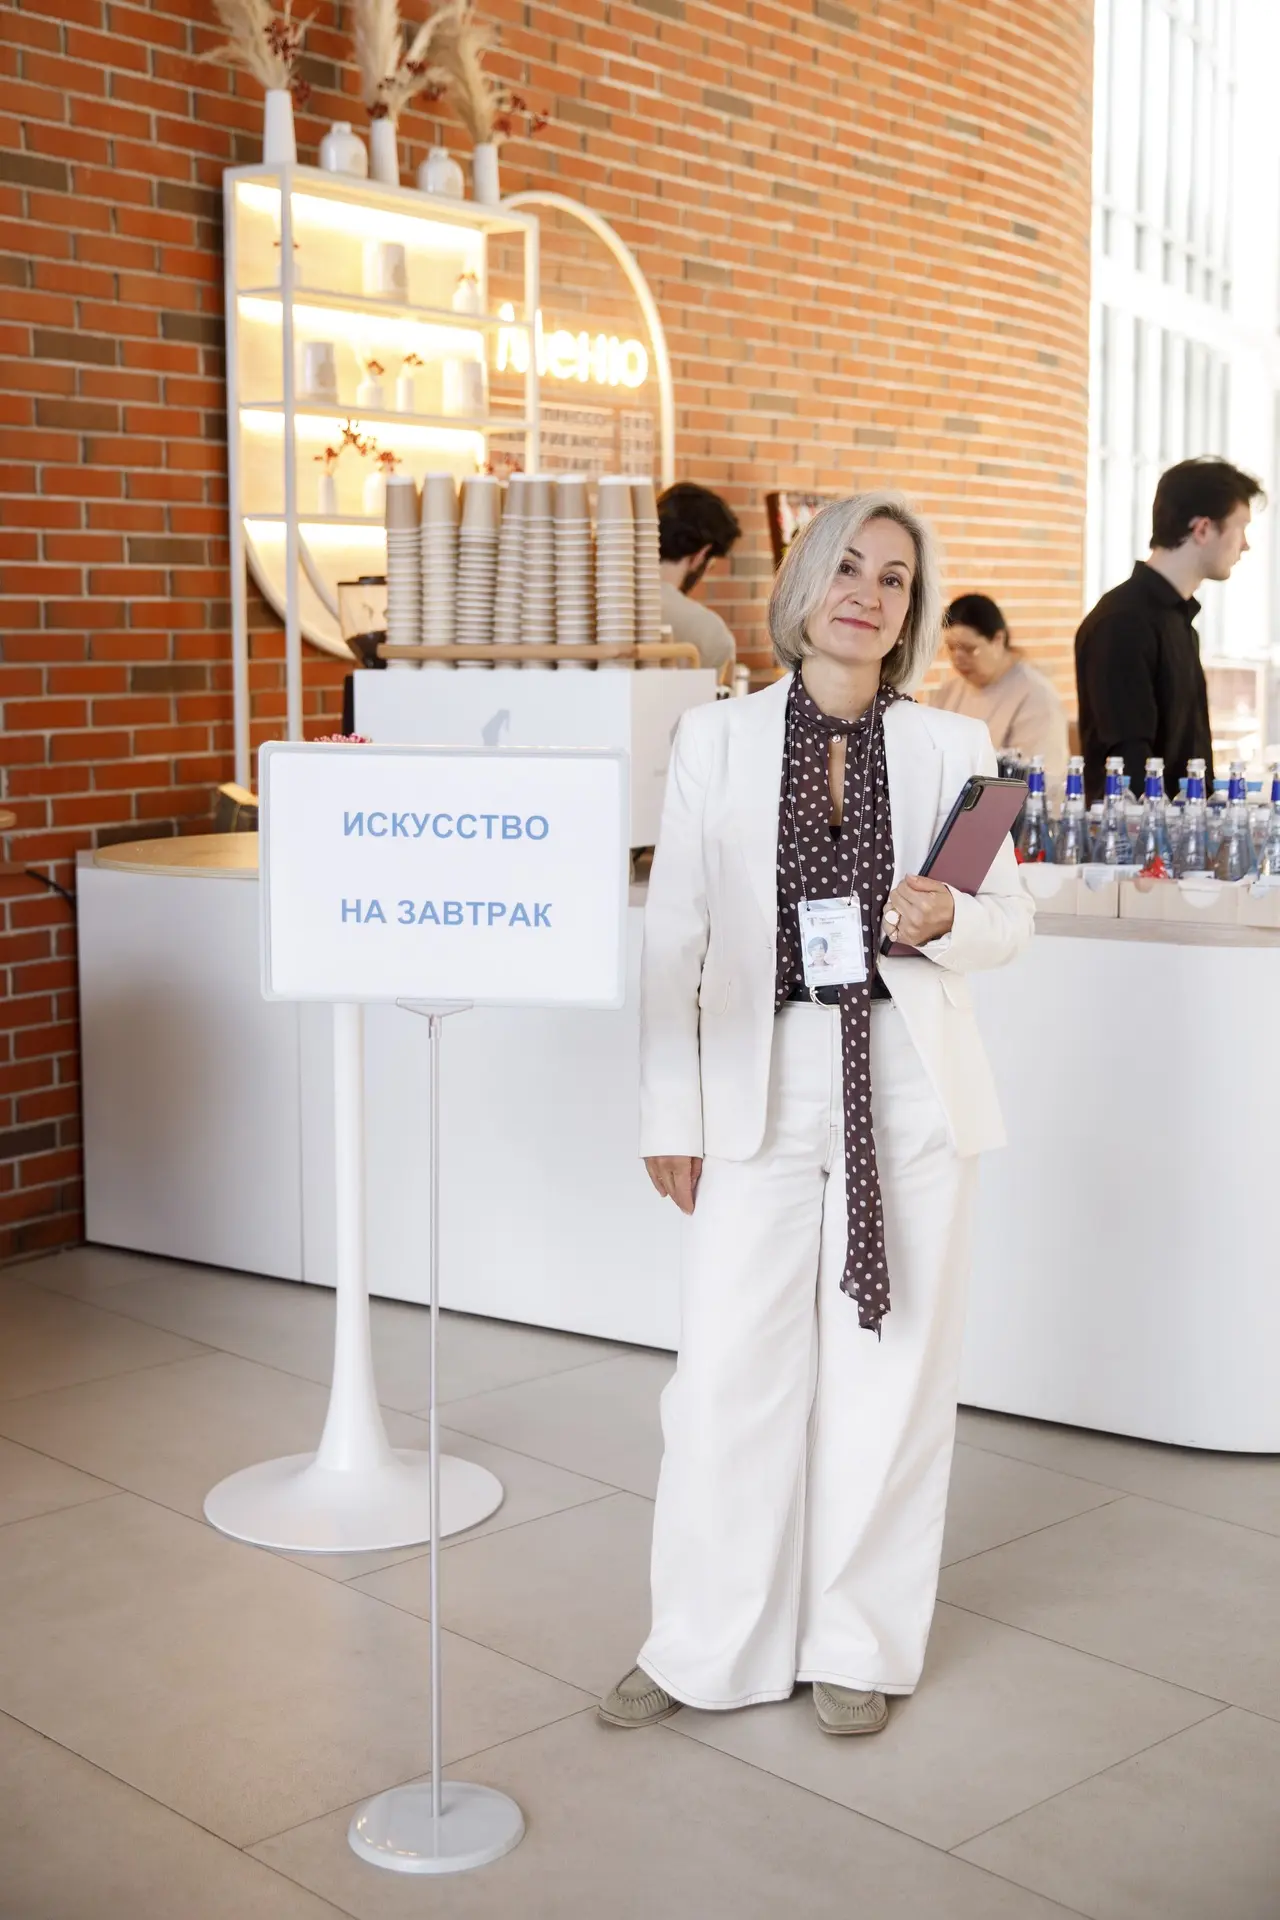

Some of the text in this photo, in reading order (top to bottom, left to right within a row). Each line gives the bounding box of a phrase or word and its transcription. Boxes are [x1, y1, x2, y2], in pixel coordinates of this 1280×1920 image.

[343, 811, 550, 841] ИСКУССТВО
[341, 898, 553, 928] НА ЗАВТРАК
